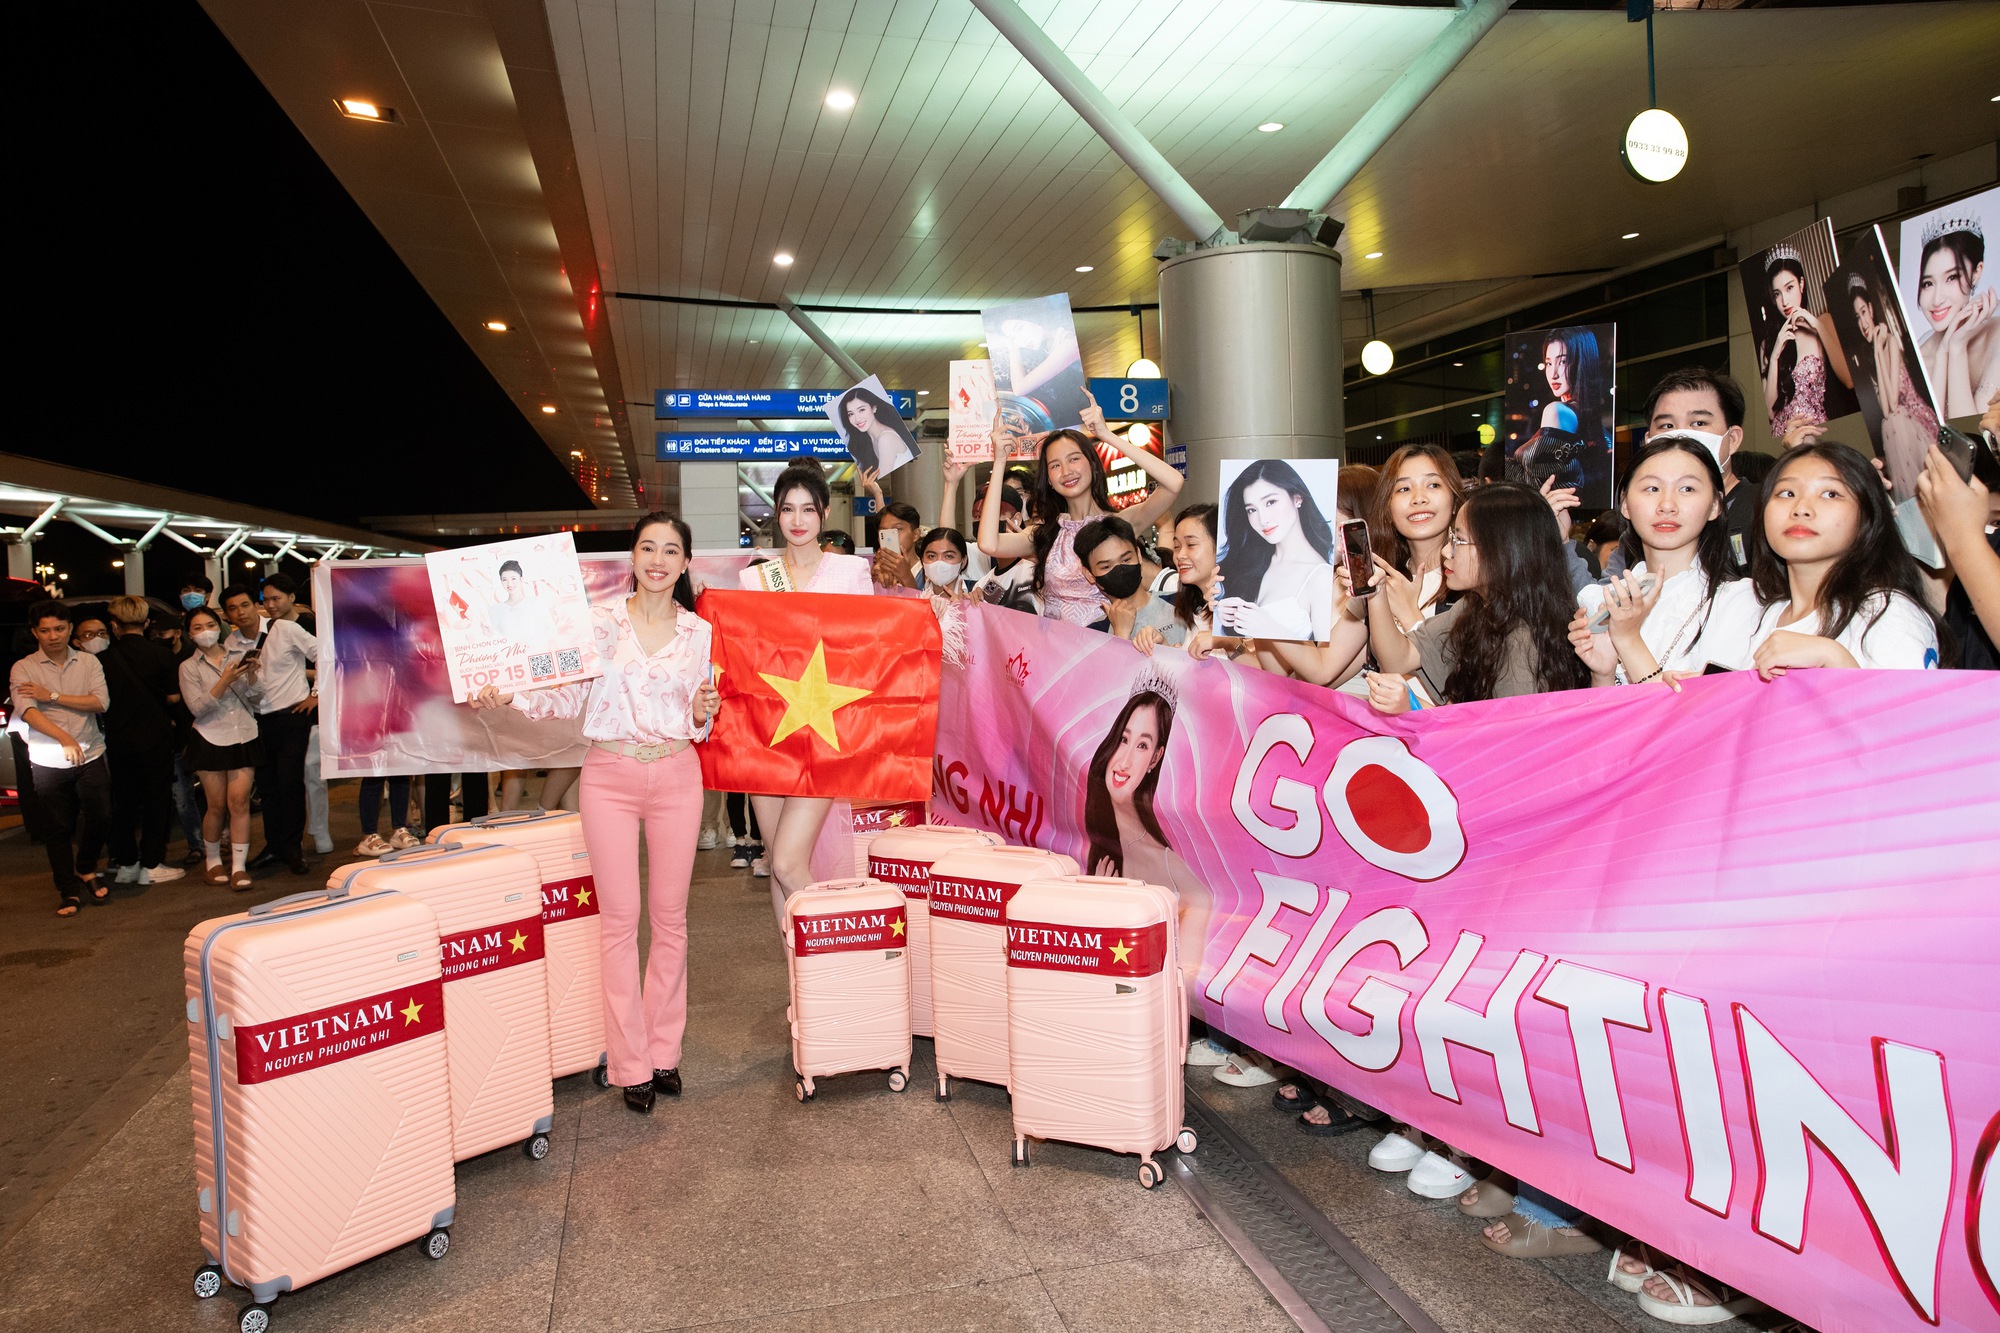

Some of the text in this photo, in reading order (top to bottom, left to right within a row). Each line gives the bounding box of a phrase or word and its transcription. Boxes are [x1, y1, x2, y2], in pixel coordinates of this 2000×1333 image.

[1628, 140, 1649, 151] 0933
[1650, 144, 1661, 153] 33
[1675, 149, 1685, 158] 88
[799, 395, 817, 403] ĐƯA
[1119, 383, 1139, 413] 8
[1151, 404, 1163, 414] 2F
[710, 437, 726, 445] TIẾP
[758, 437, 774, 445] ĐẾN
[802, 438, 819, 446] D.VỤ
[819, 438, 834, 446] TRỢ
[955, 443, 982, 454] TOP
[813, 446, 844, 454] Passenger
[867, 499, 877, 513] 9
[769, 567, 784, 588] MISS
[492, 637, 508, 646] CHO
[500, 642, 527, 659] Nhi
[460, 668, 500, 689] TOP
[505, 663, 525, 681] 15
[1231, 711, 1468, 881] GO
[979, 772, 1044, 848] NHI
[929, 880, 1002, 903] VIETNAM
[550, 907, 566, 918] NHI
[930, 900, 999, 918] NGUYEN PHUONG NHI
[798, 914, 886, 935] VIETNAM
[805, 933, 882, 948] NGUYEN PHUONG NHI
[1008, 926, 1102, 950] VIETNAM
[482, 955, 499, 967] NHI
[1010, 949, 1099, 967] NGUYEN PHUONG NHI
[255, 1000, 394, 1053] VIETNAM
[264, 1028, 390, 1073] NGUYEN PHUONG NHI
